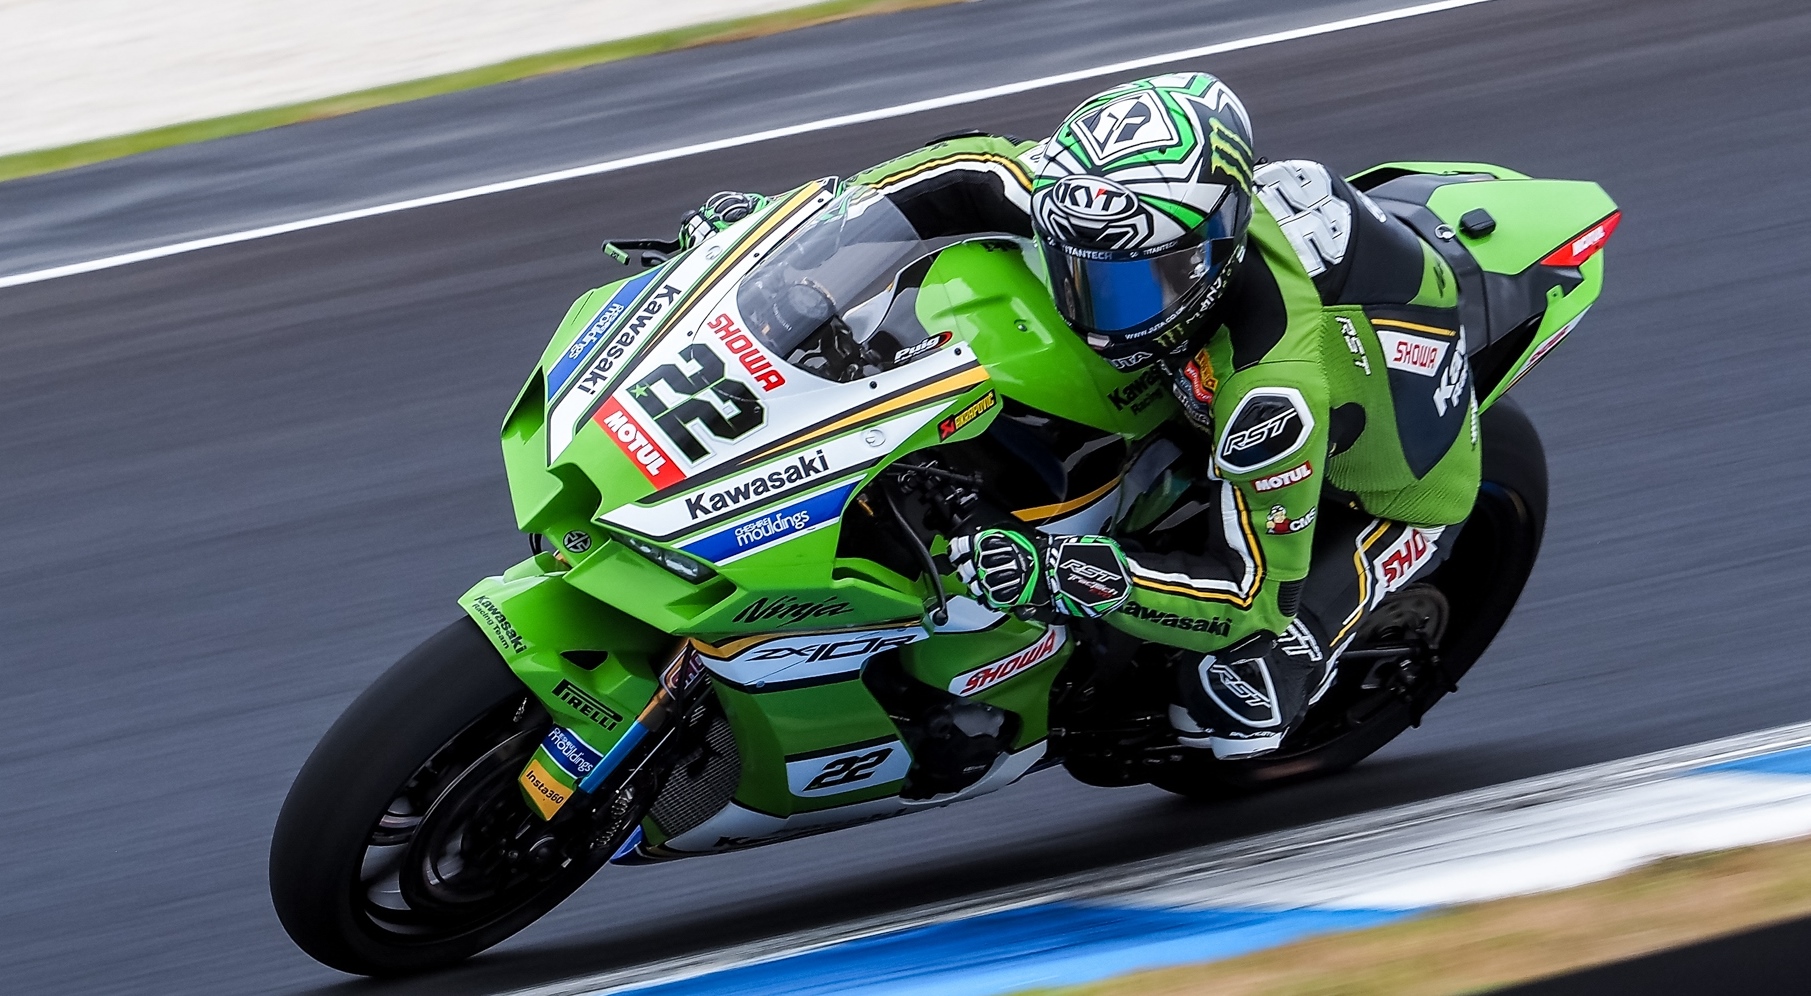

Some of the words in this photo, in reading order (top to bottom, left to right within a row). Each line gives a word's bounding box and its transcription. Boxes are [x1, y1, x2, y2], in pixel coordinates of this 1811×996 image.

[1059, 182, 1127, 212] KYT
[1061, 243, 1113, 260] TITANTECH
[577, 284, 682, 396] Kawasaki
[707, 313, 786, 393] SHOWA
[894, 335, 941, 361] Puig
[1393, 341, 1439, 369] SHOWA
[626, 343, 765, 464] 22
[603, 410, 668, 477] MOTUL
[1223, 407, 1298, 457] RST
[685, 449, 830, 520] Kawasaki
[1254, 463, 1312, 492] MOTUL
[736, 510, 811, 547] mouldings
[1059, 558, 1123, 583] RST
[471, 603, 494, 627] Racing
[492, 624, 510, 650] Team
[474, 595, 528, 654] Kawasaki
[732, 596, 854, 628] Ninja
[959, 630, 1055, 696] SHOWA
[551, 678, 624, 732] PIRELLI
[1210, 663, 1271, 709] RST
[548, 730, 594, 772] mouldings
[802, 747, 896, 792] 22
[525, 769, 565, 805] Insta360
